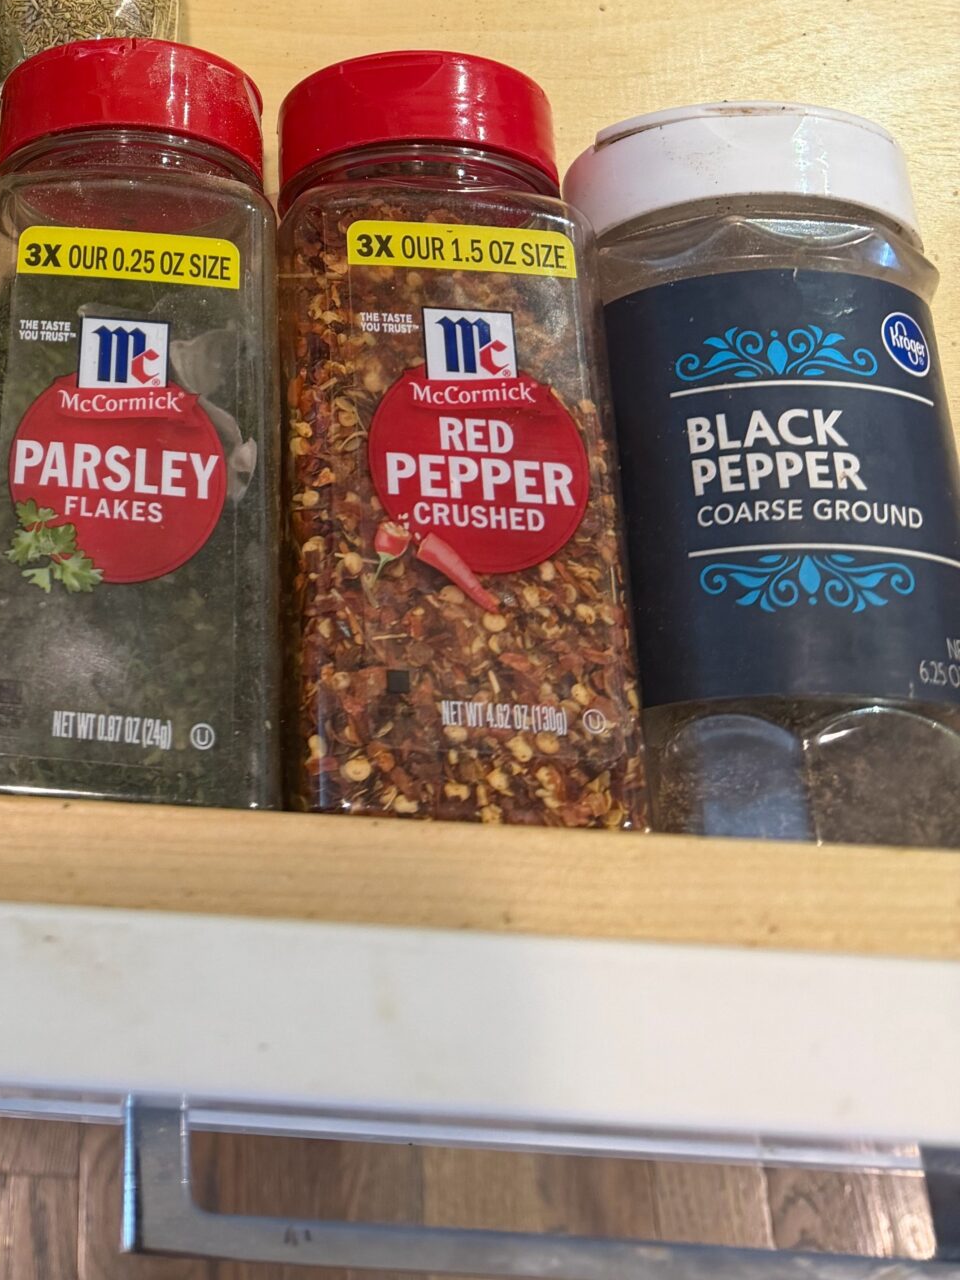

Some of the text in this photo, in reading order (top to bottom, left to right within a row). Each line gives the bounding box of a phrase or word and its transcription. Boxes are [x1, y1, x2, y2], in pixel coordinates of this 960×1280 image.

[24, 243, 231, 280] 3X OUR 0.25 OZ SIZE
[356, 233, 567, 270] 3X OUR 1.5 OZ SIZE
[19, 329, 38, 341] YOU
[20, 319, 71, 332] THE TASTE
[359, 312, 413, 324] THE TASTE
[360, 321, 380, 332] YOU
[890, 321, 926, 367] Kroger
[57, 389, 183, 413] McCormick
[409, 382, 536, 405] McCormick
[439, 416, 515, 454] RED
[686, 408, 848, 455] BLACK
[13, 439, 219, 500] PARSLEY
[385, 451, 576, 507] PEPPER
[691, 450, 868, 497] PEPPER
[64, 496, 164, 523] FLAKES
[413, 501, 545, 532] CRUSHED
[696, 499, 923, 530] COARSE GROUND
[52, 710, 172, 750] NET WT 0.87 OZ (24g)
[441, 700, 567, 736] NET WT 4.62 OZ (130g)
